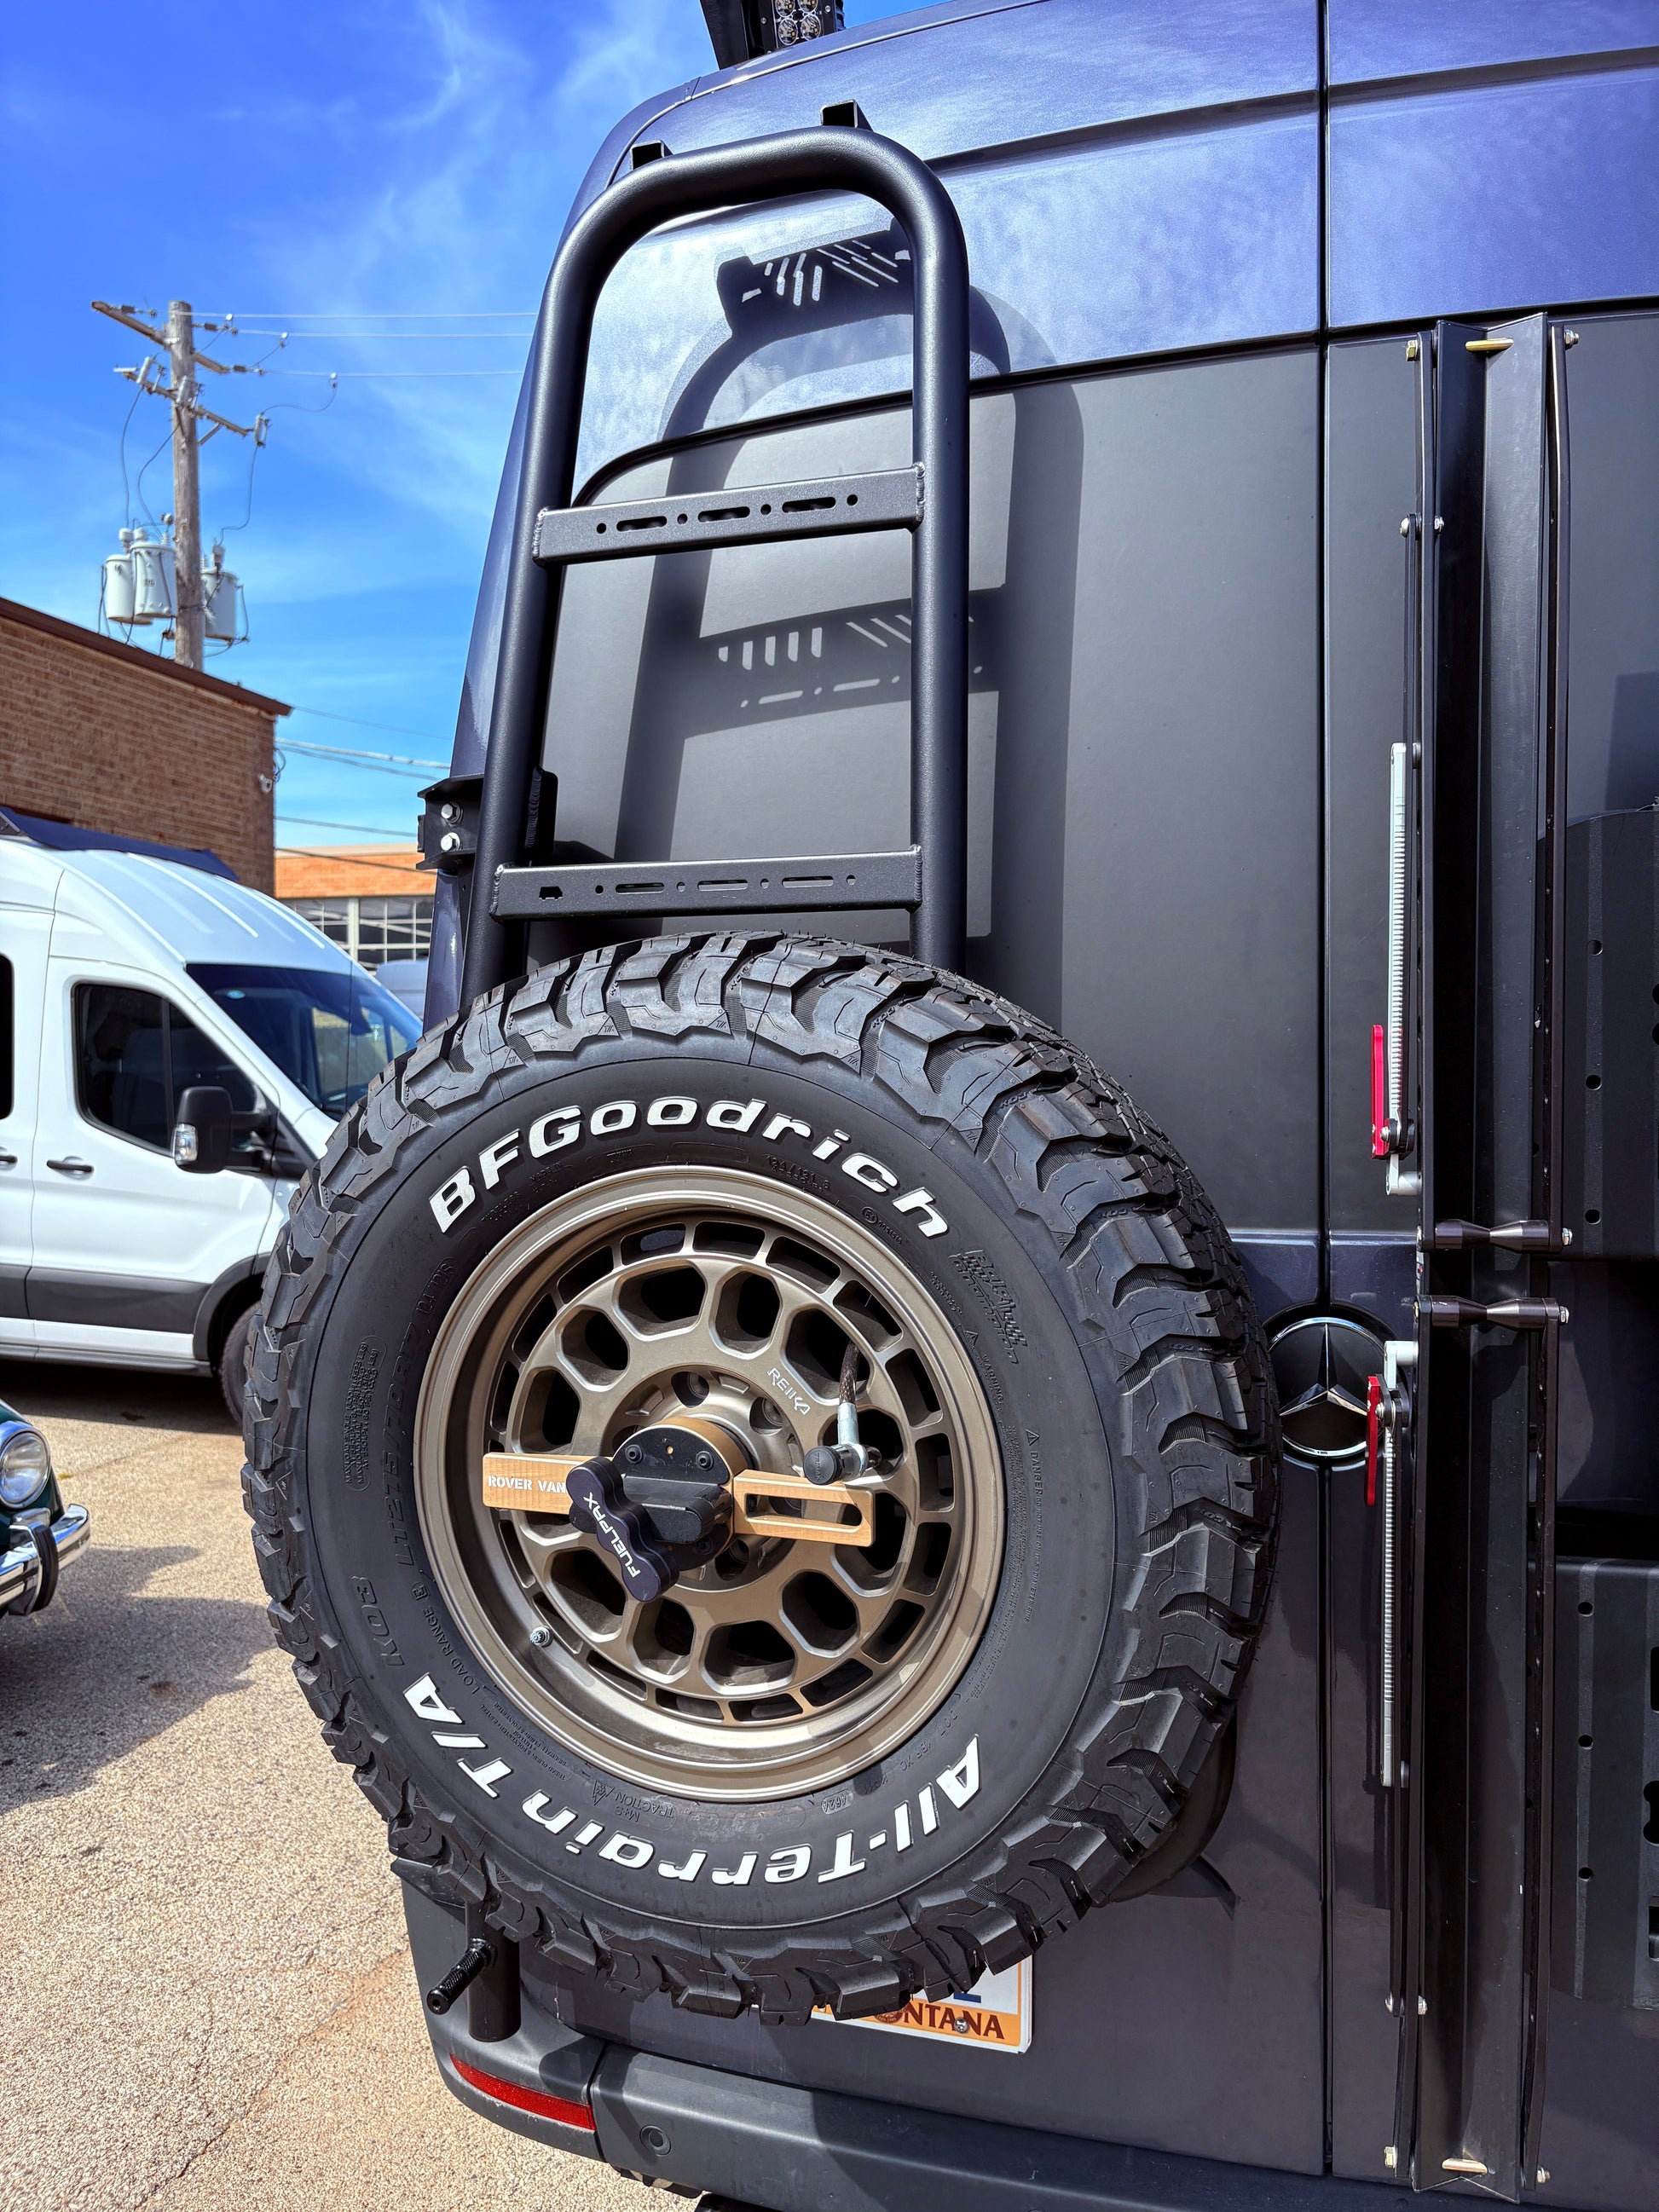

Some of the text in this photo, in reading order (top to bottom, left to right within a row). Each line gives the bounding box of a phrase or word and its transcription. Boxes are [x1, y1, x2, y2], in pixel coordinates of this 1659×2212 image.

[428, 1097, 951, 1239] BFGoodrich
[488, 1476, 533, 1491] ROVER
[1029, 1451, 1043, 1495] DANGER
[583, 1492, 641, 1578] FUELPAX
[350, 1575, 406, 1666] KO3
[422, 1605, 454, 1657] RANGE
[450, 1657, 480, 1695] LOAD
[403, 1672, 515, 1799] T/A
[521, 1734, 980, 1886] All-Terrain
[613, 1790, 675, 1819] TRACTION
[903, 2001, 1005, 2040] NTANA
